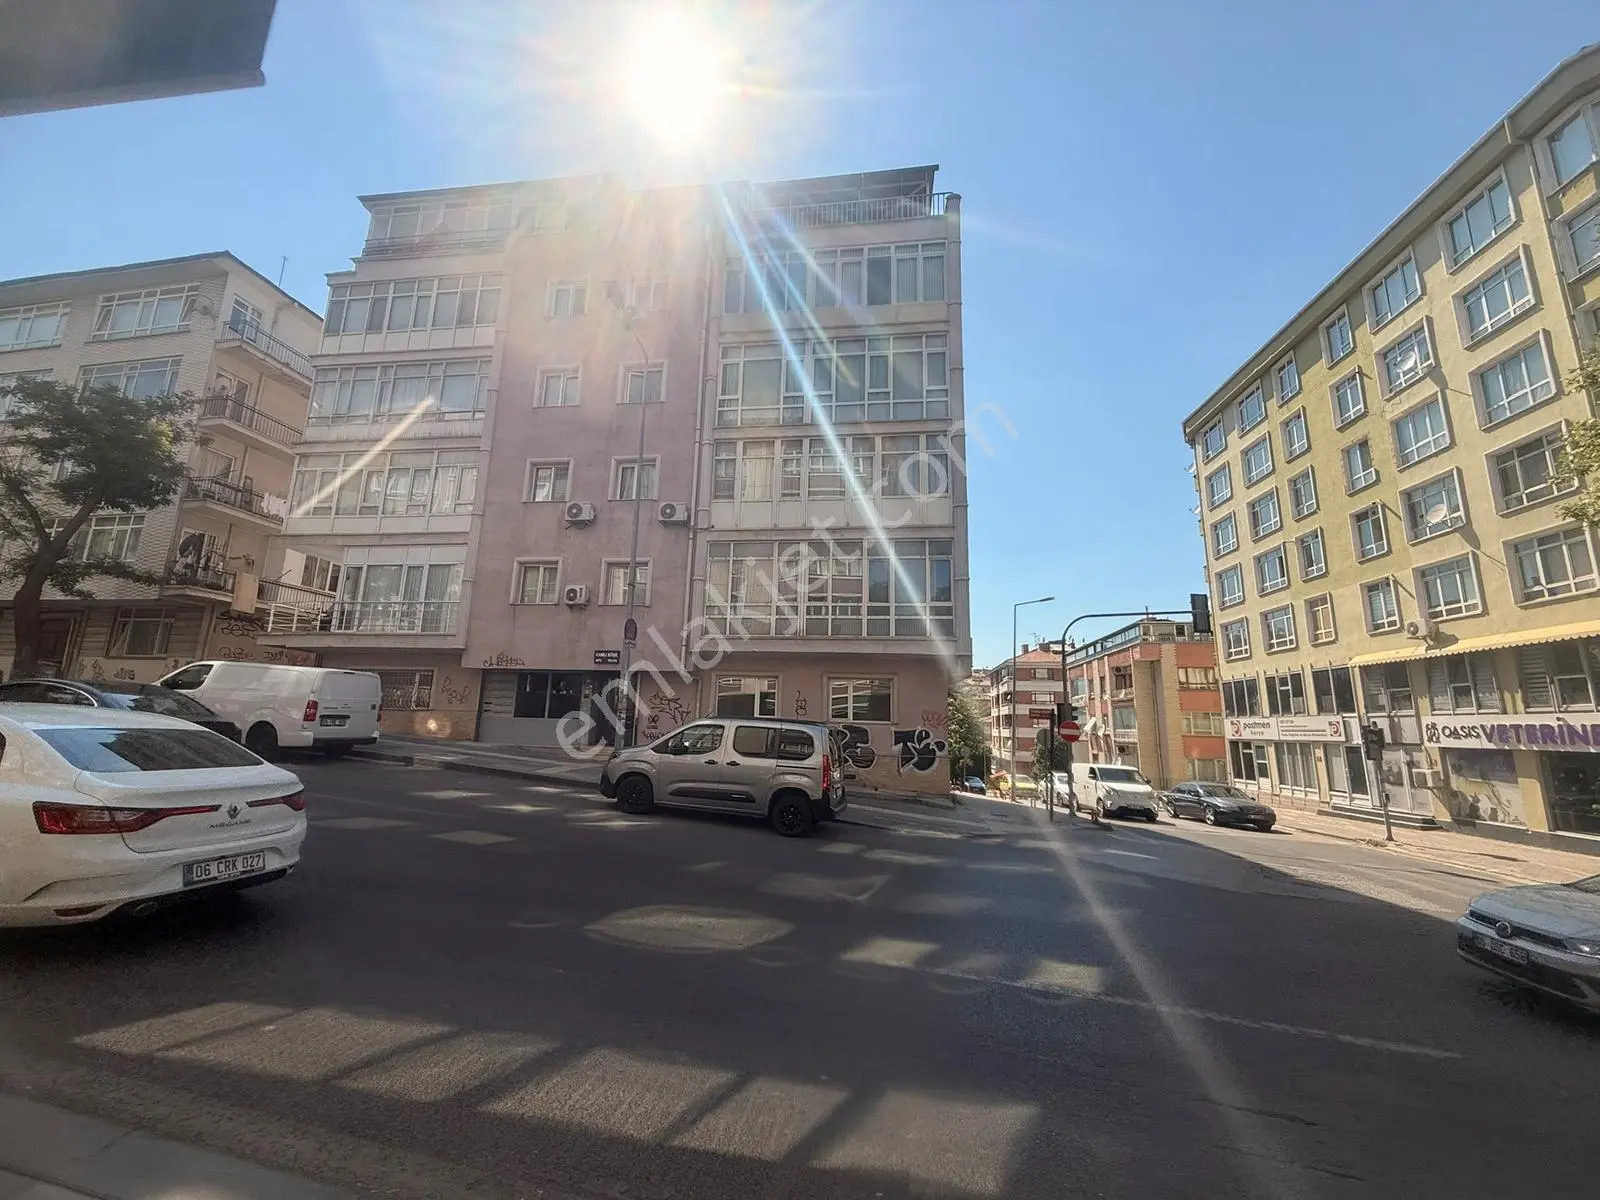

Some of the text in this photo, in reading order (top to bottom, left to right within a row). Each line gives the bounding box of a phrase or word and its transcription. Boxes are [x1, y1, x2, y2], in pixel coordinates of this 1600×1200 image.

[1243, 721, 1271, 731] postmen
[195, 864, 211, 879] 06
[216, 859, 239, 874] CRK
[242, 854, 263, 869] 027
